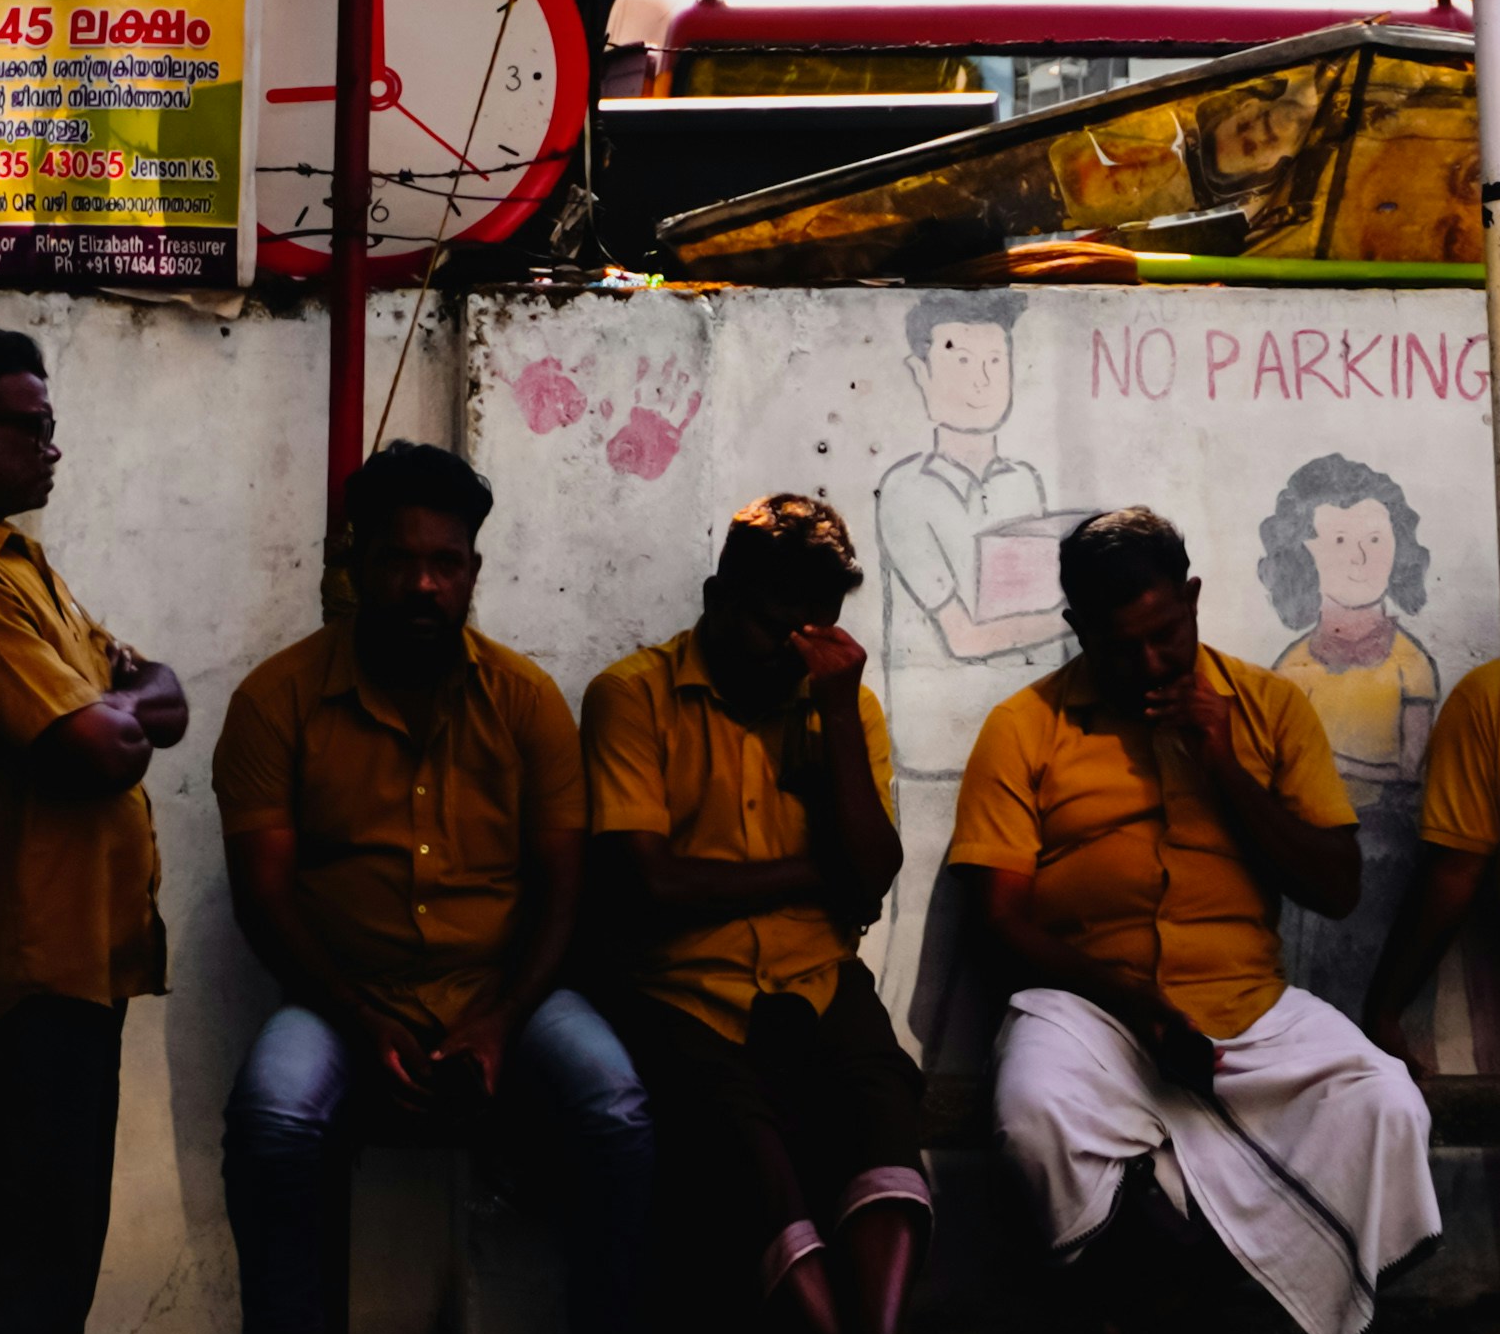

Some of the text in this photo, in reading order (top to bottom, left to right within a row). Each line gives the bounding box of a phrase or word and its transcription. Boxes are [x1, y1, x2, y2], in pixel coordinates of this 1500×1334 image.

[69, 8, 211, 46] ലക്ഷം
[505, 65, 522, 92] 3
[38, 150, 125, 179] 43055
[131, 155, 187, 178] Jenson
[12, 193, 37, 212] QR
[371, 199, 389, 223] 6
[35, 234, 75, 256] Rincy
[79, 234, 144, 254] Elizabath
[158, 235, 227, 255] Treasurer
[54, 255, 73, 273] Ph
[86, 255, 110, 274] +91
[114, 255, 155, 275] 97464
[160, 255, 202, 275] 50502
[1091, 326, 1491, 402] NO PARKING
